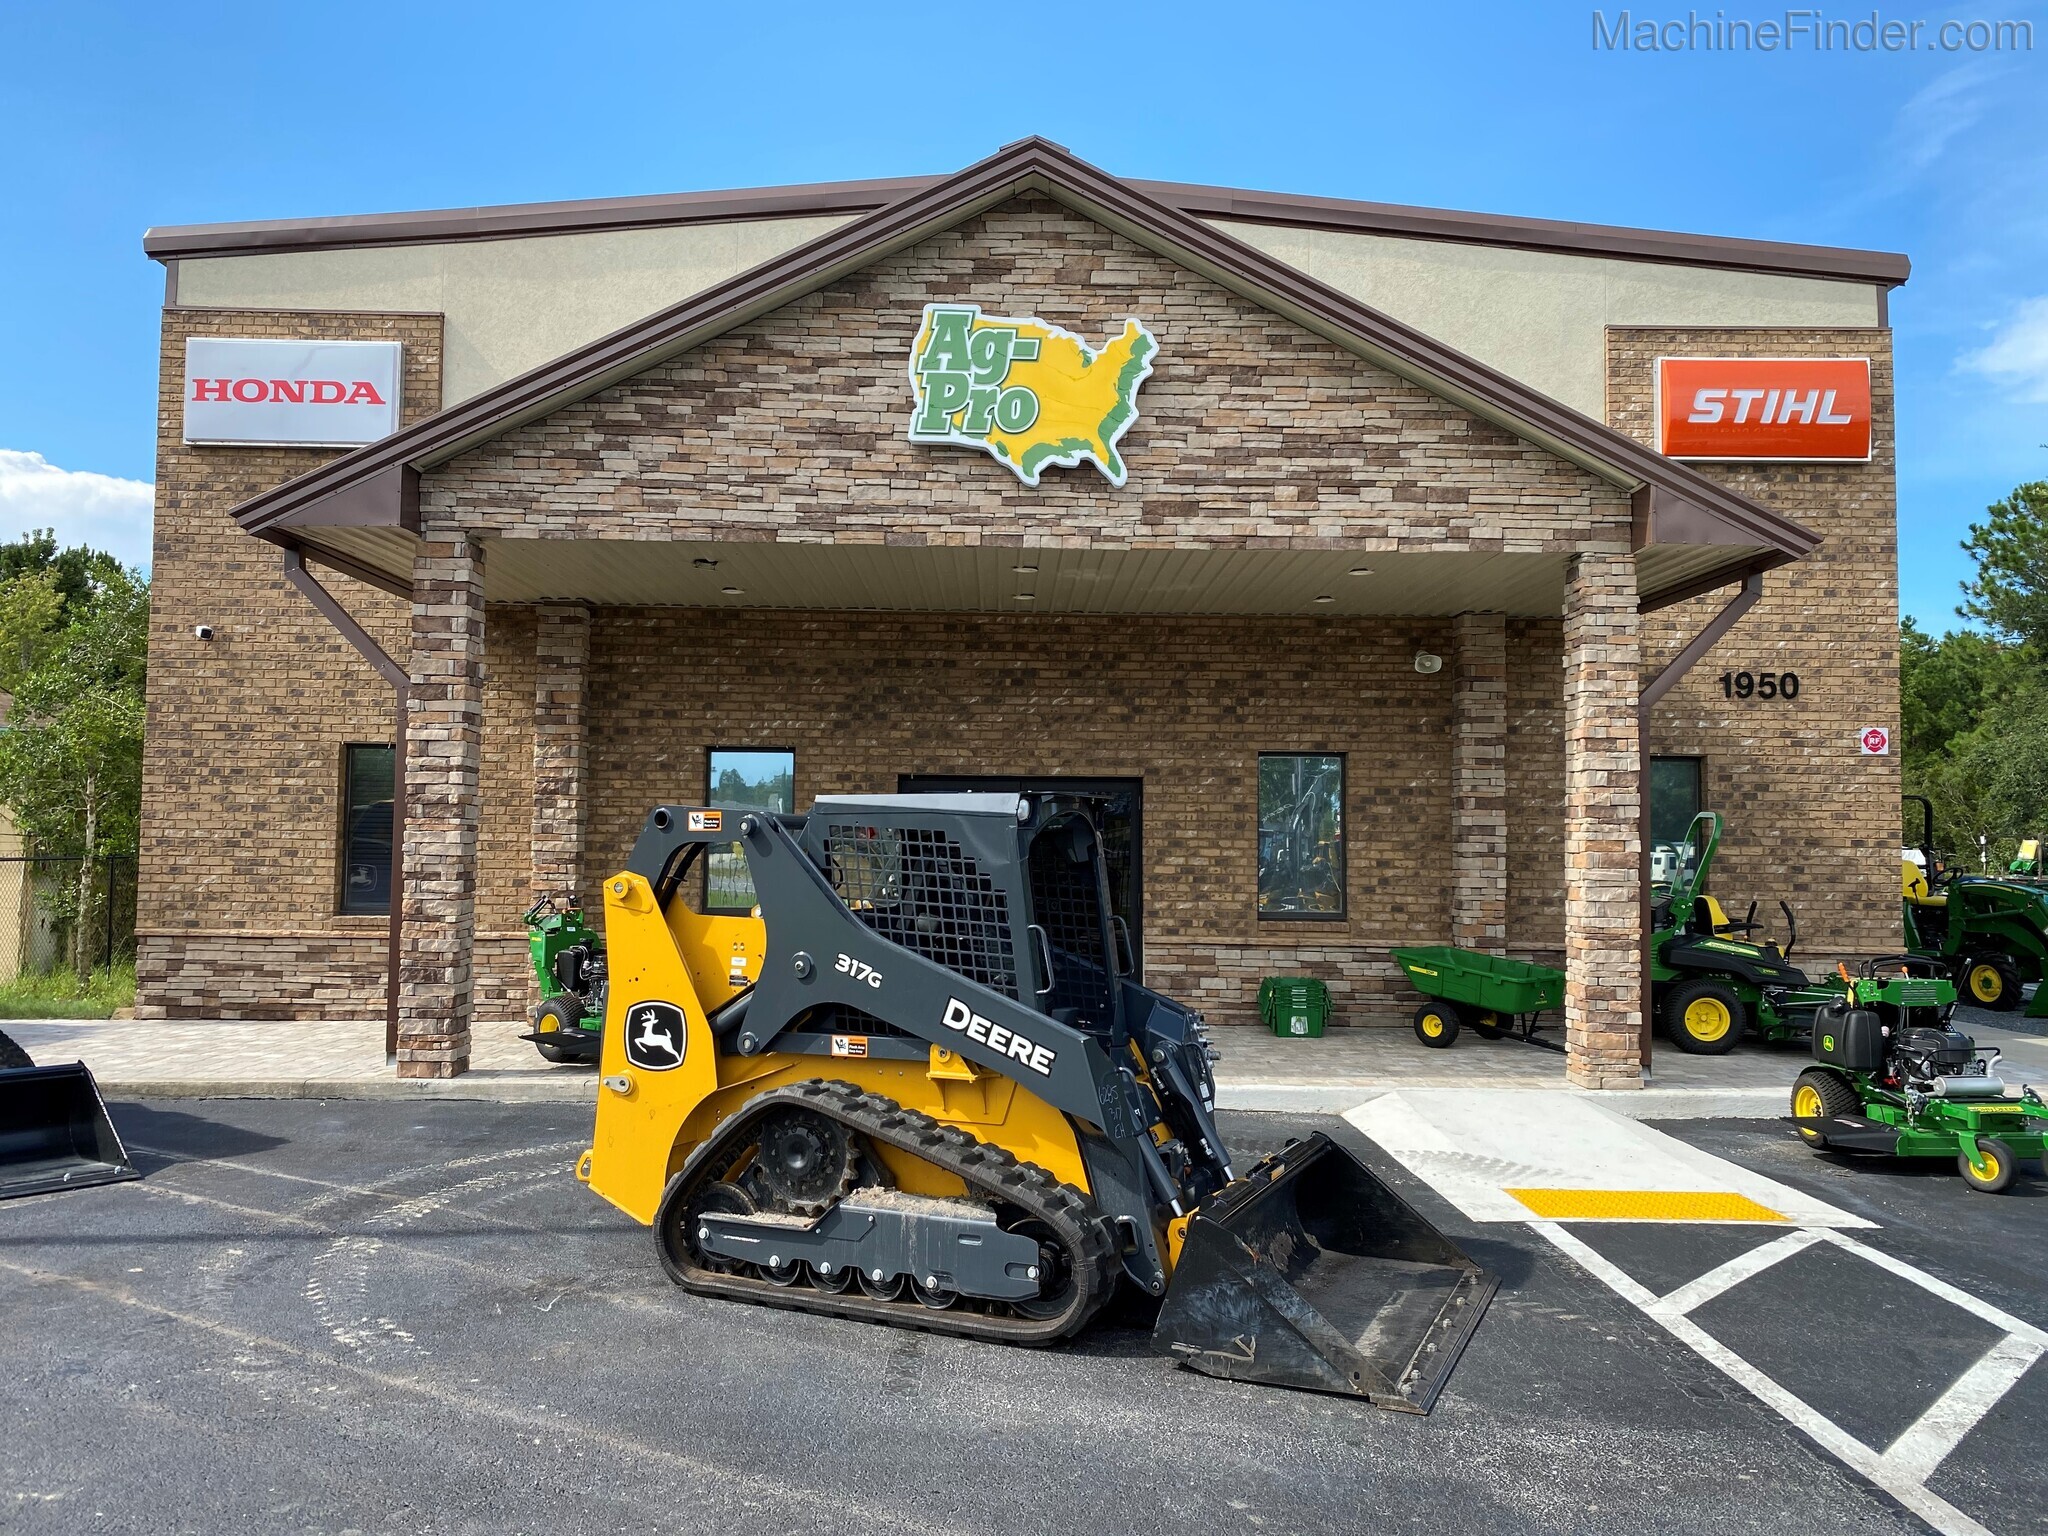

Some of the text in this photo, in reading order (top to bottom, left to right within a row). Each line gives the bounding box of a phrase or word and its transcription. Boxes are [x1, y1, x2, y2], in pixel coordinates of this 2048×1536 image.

[916, 310, 1042, 386] Ag-
[191, 378, 386, 405] HONDA
[914, 372, 1040, 435] Pro
[1687, 388, 1852, 425] STIHL
[1719, 671, 1800, 700] 1950
[1869, 737, 1880, 745] RF
[834, 952, 884, 989] 317G
[940, 996, 1058, 1078] DEERE
